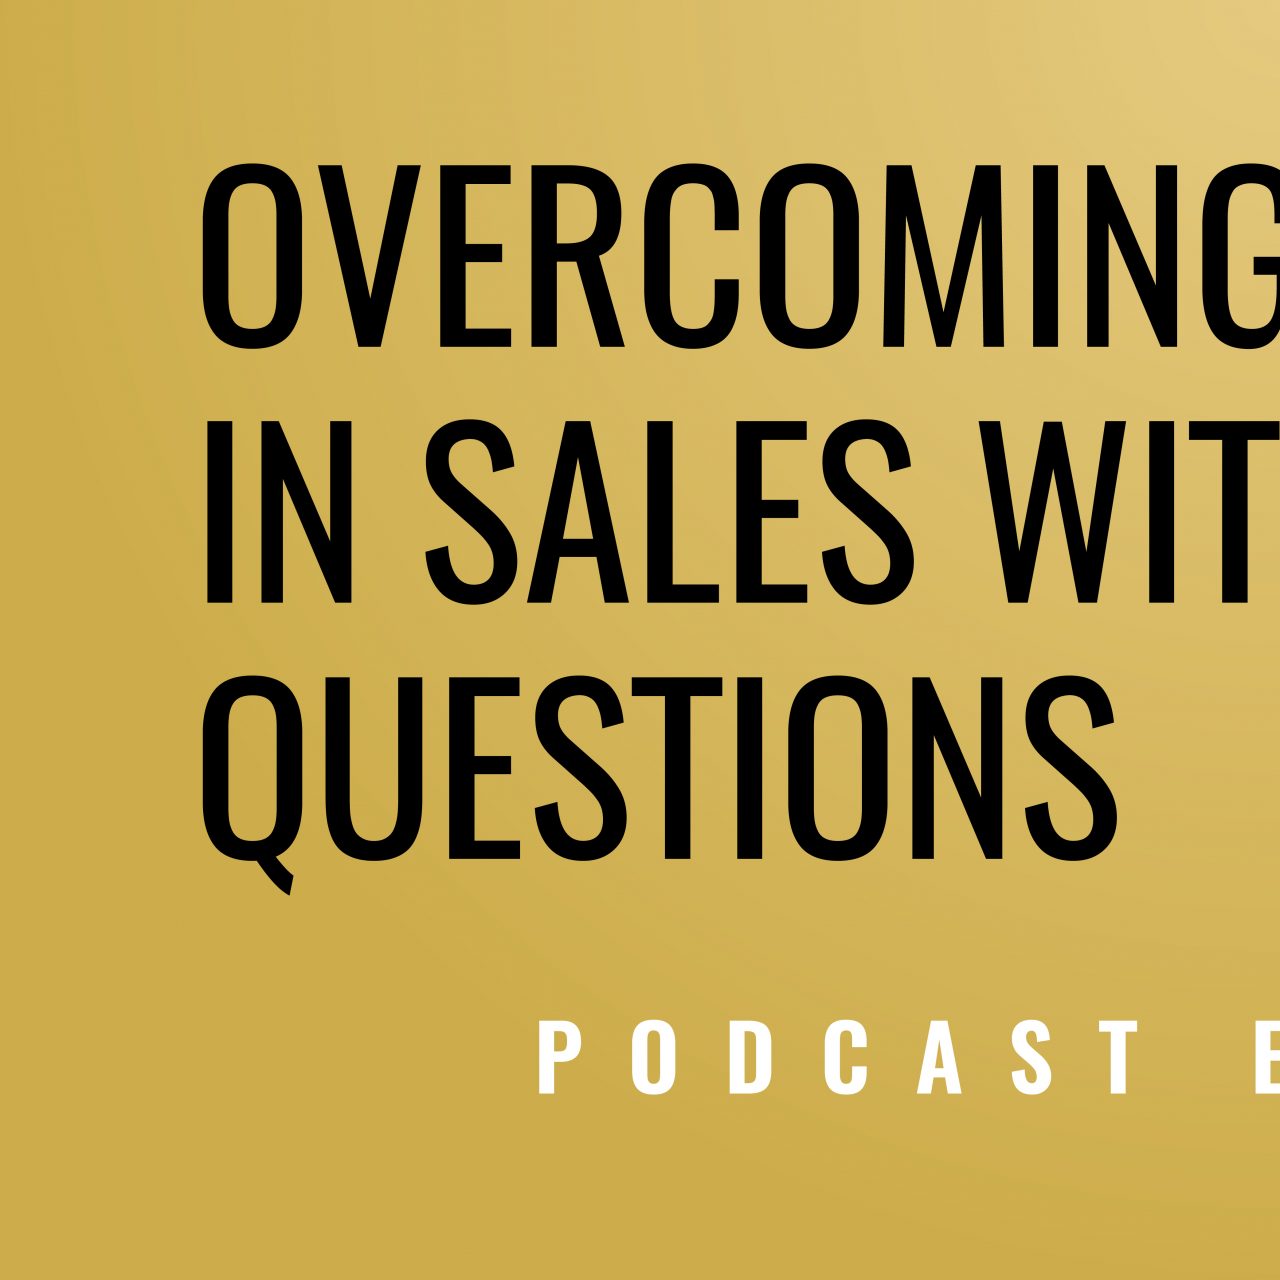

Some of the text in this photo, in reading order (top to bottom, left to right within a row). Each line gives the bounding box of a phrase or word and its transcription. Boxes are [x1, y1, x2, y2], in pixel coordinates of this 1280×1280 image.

[205, 421, 353, 604] IN
[424, 418, 914, 605] SALES
[201, 676, 1119, 895] QUESTIONS
[539, 1020, 1137, 1094] PODCAST
